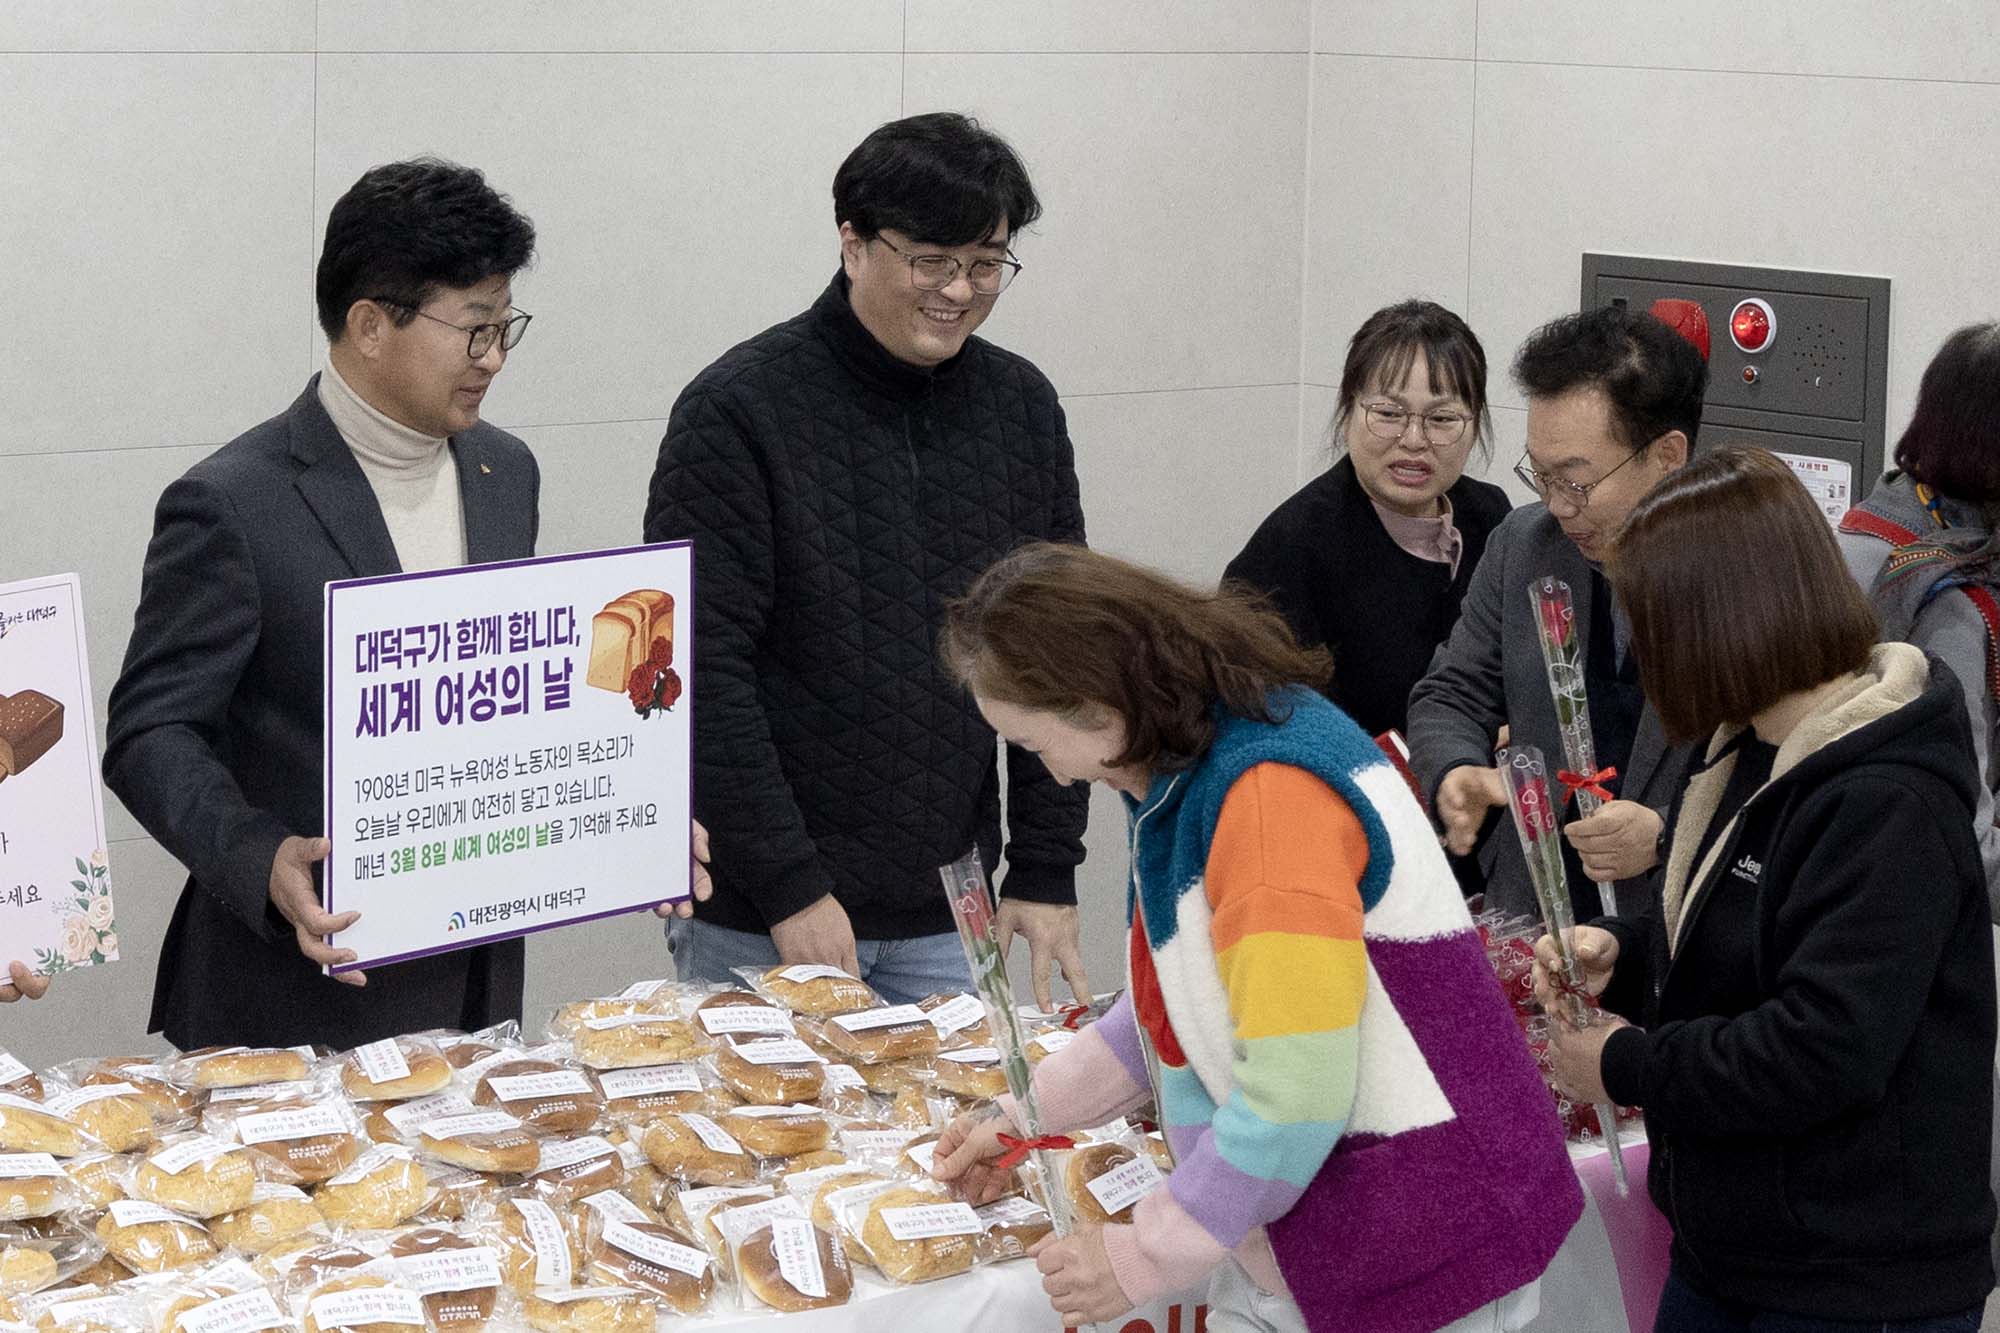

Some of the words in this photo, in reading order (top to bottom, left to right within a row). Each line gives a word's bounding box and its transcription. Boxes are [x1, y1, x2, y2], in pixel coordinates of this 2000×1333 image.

[356, 622, 451, 673] 대덕구가
[456, 615, 501, 660] 함께
[508, 605, 580, 653] 합니다,
[356, 679, 420, 738] 세계
[435, 663, 529, 725] 여성의
[544, 657, 573, 711] 날
[355, 772, 408, 803] 1908년
[416, 766, 444, 792] 미국
[450, 755, 508, 787] 뉴욕여성
[515, 745, 571, 776] 노동자의
[577, 735, 633, 764] 목소리가
[355, 811, 401, 842] 오늘날
[406, 800, 466, 832] 우리에게
[472, 791, 515, 820] 여전히
[522, 786, 549, 812] 닿고
[555, 775, 615, 806] 있습니다.
[355, 852, 384, 880] 매년
[391, 847, 415, 874] 3월
[422, 841, 446, 868] 8일
[452, 834, 481, 861] 세계
[487, 826, 529, 854] 여성의
[536, 820, 563, 847] 날을
[570, 811, 610, 839] 기억해
[616, 803, 657, 832] 주세요
[470, 896, 540, 925] 대전광역시
[545, 888, 585, 909] 대덕구
